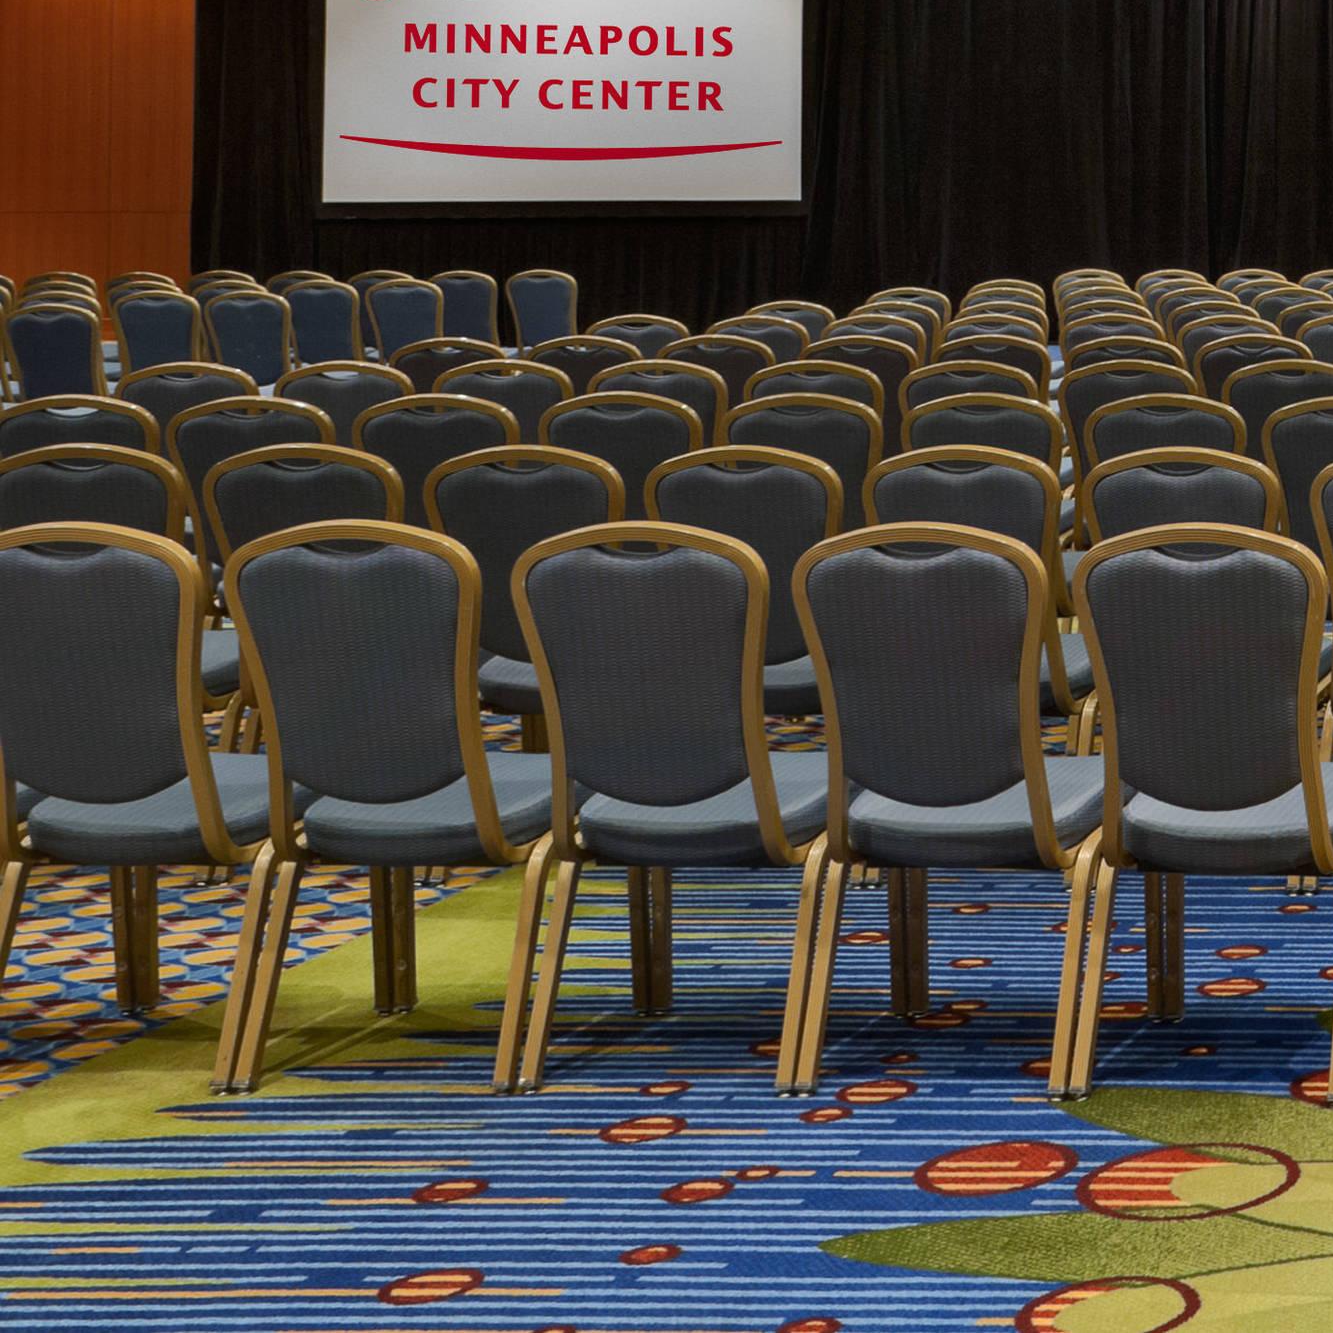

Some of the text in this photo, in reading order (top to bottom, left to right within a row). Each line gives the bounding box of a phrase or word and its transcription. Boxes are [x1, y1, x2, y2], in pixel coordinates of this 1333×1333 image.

[403, 22, 734, 58] MINNEAPOLIS
[411, 77, 724, 112] CITY CENTER
